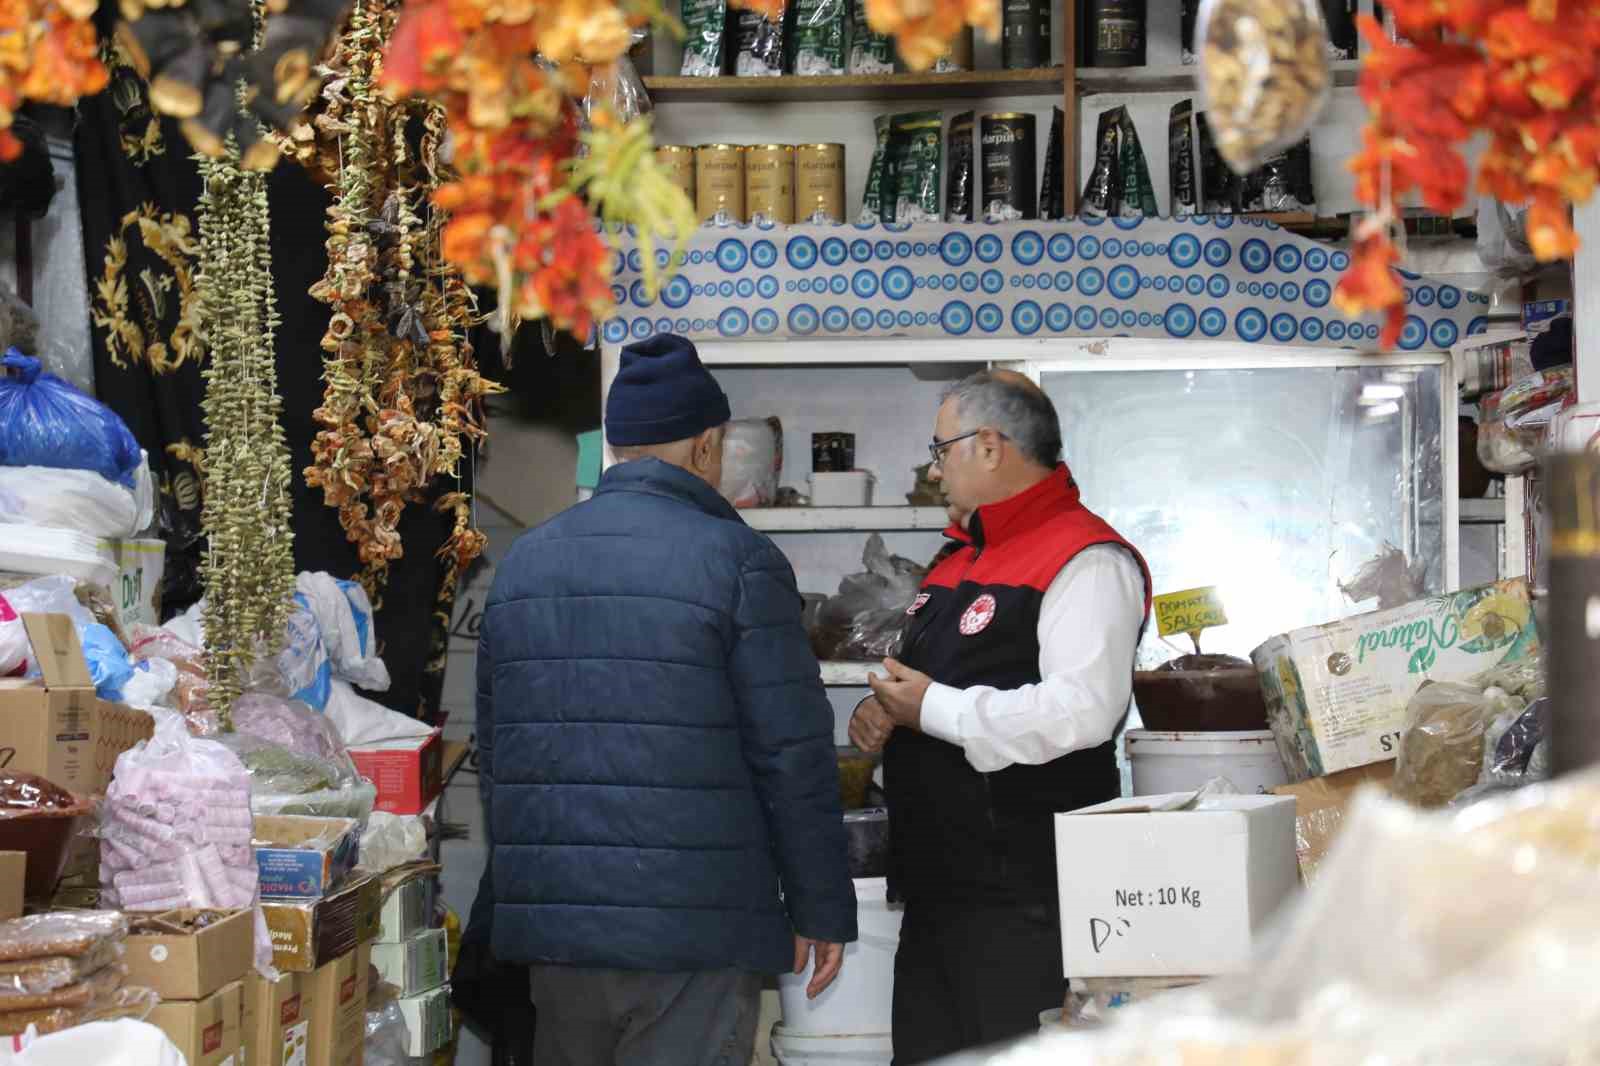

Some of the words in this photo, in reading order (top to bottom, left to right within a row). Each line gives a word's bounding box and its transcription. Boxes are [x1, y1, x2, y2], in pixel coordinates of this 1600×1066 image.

[1357, 614, 1459, 664] Natural
[1115, 889, 1144, 907] Net
[1158, 887, 1177, 905] 10
[1180, 886, 1201, 908] Kg
